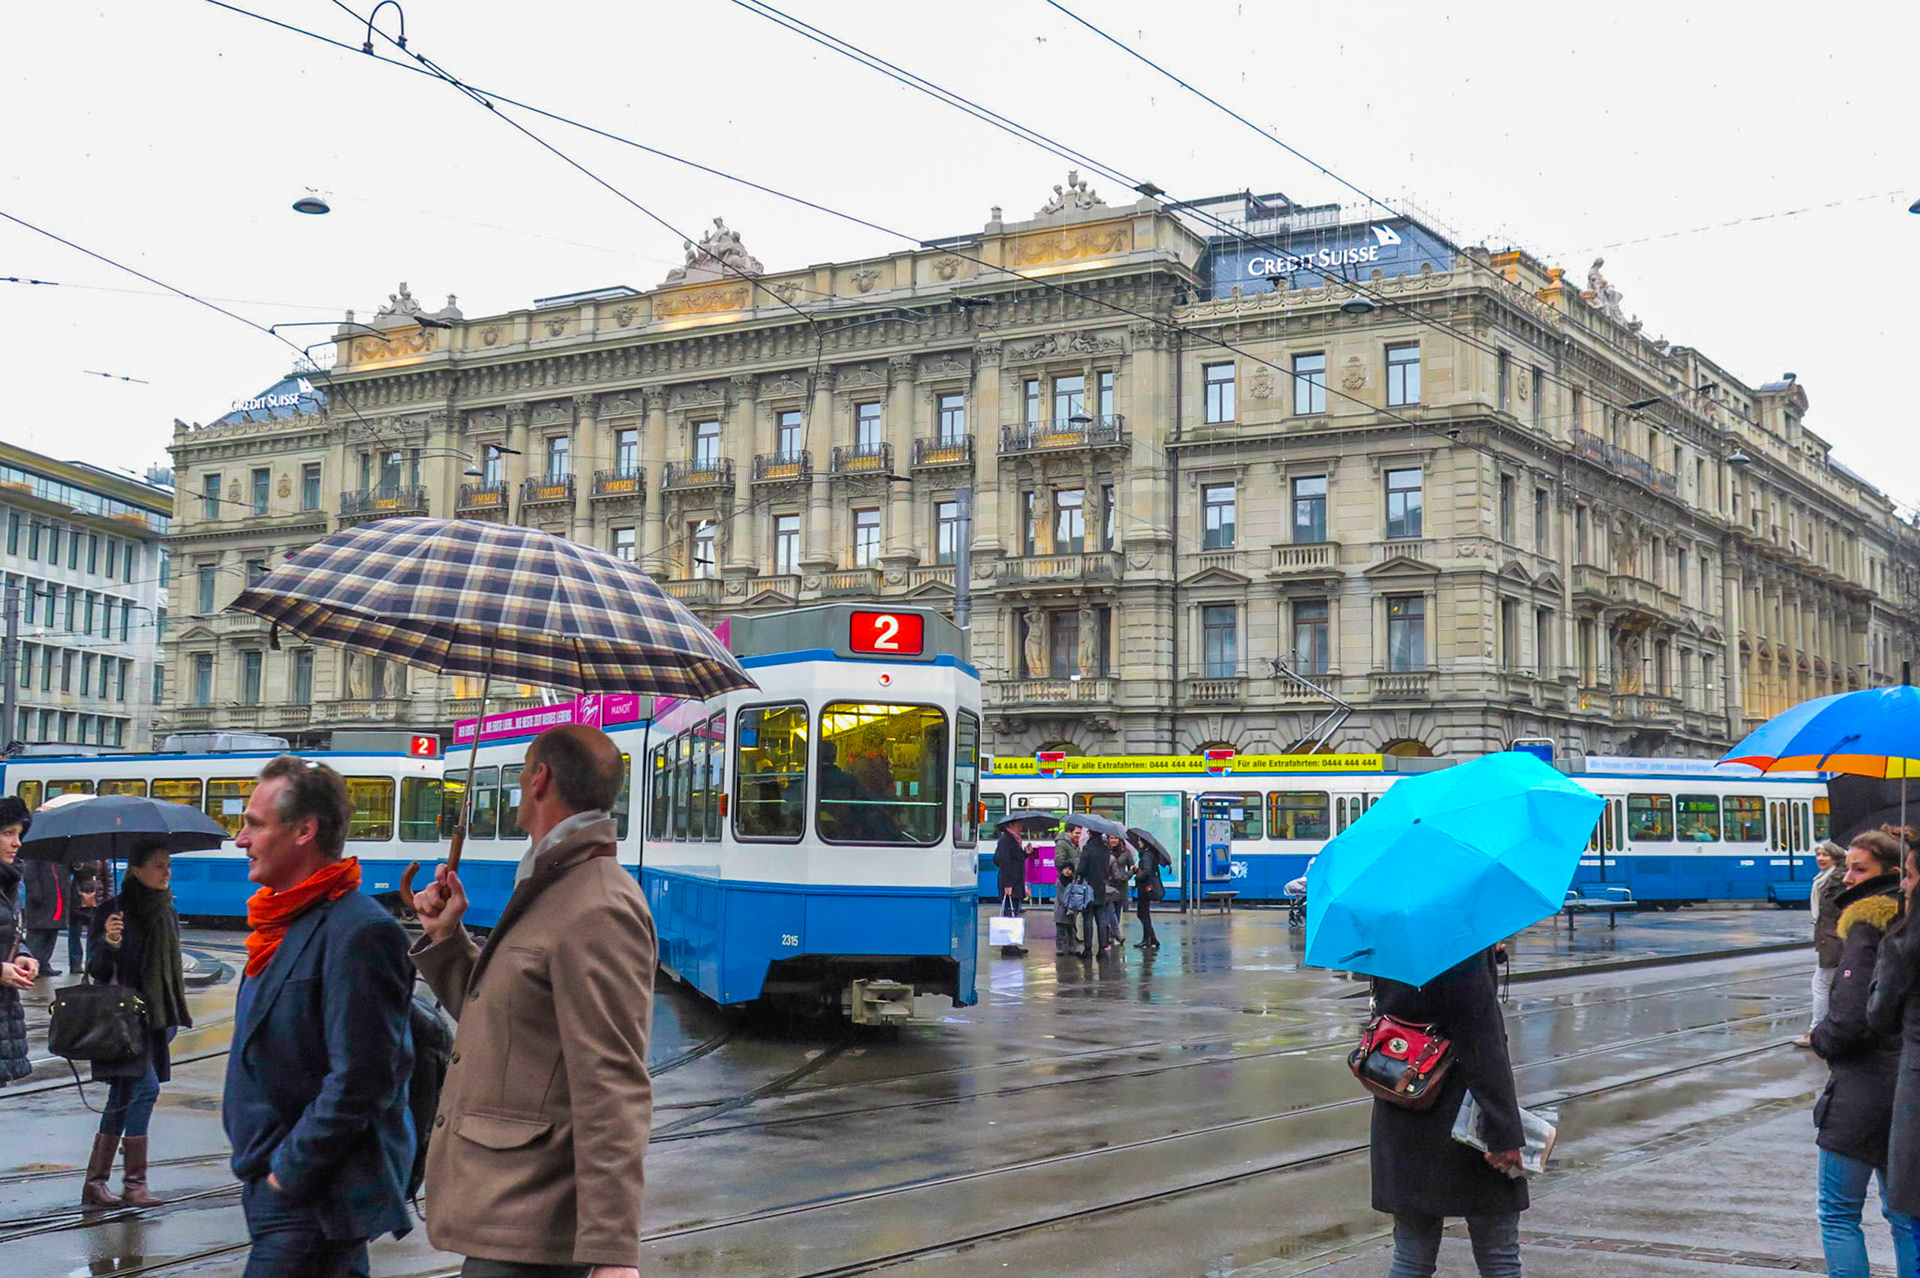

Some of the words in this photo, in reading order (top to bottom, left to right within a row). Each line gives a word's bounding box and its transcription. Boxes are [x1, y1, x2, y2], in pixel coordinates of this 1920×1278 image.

[1248, 253, 1316, 277] CREDIT
[1318, 245, 1379, 267] SUISSE
[230, 397, 267, 413] CREDIT
[267, 393, 301, 408] SUISSE
[874, 615, 899, 650] 2
[418, 738, 428, 754] 2
[1067, 761, 1079, 769] Für
[1082, 761, 1095, 769] alle
[1097, 761, 1147, 769] Extrafahrten:
[1237, 760, 1250, 768] Für
[1269, 759, 1320, 767] Extrafahrten:
[1322, 759, 1342, 767] 0444
[1679, 802, 1685, 811] 7
[781, 934, 799, 946] 2315
